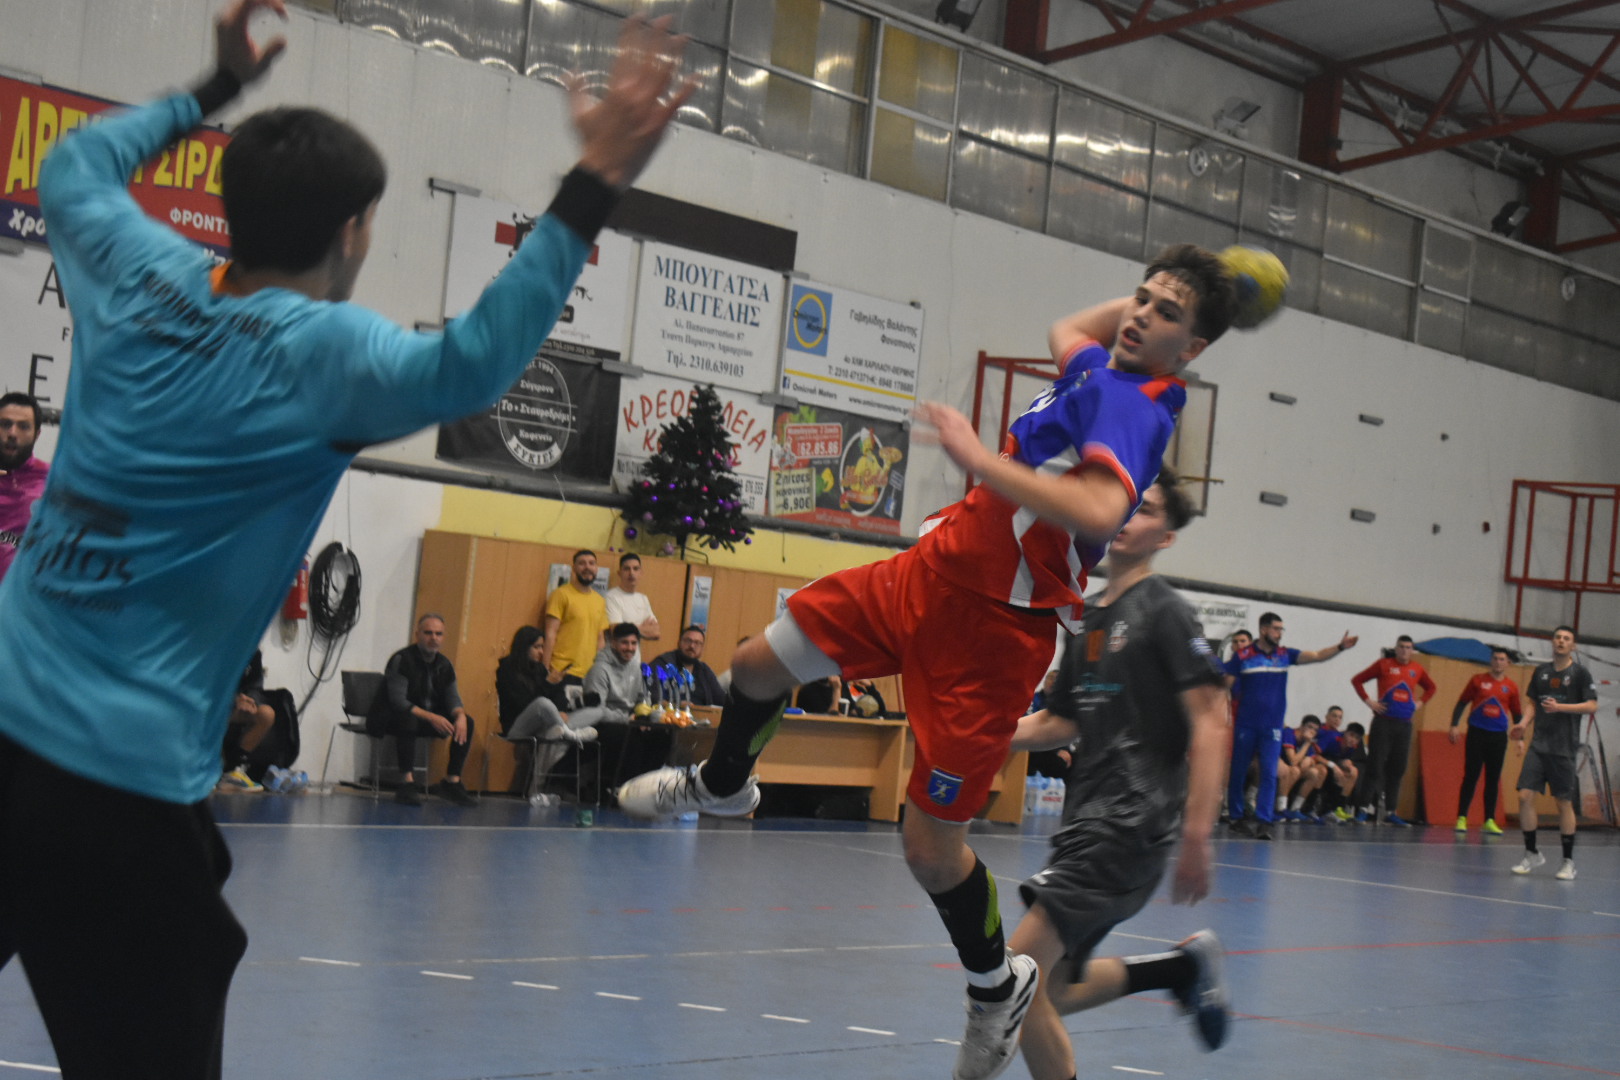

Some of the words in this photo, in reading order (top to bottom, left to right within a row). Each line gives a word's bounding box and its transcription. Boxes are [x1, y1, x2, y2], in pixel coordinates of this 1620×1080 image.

[653, 254, 770, 303] ΜΠΟΥΓΑΤΣΑ
[663, 285, 761, 328] ΒΑΓΓΕΛΗΣ
[666, 348, 687, 369] Τηλ.
[689, 354, 745, 378] 2310.639103
[501, 399, 513, 412] Το
